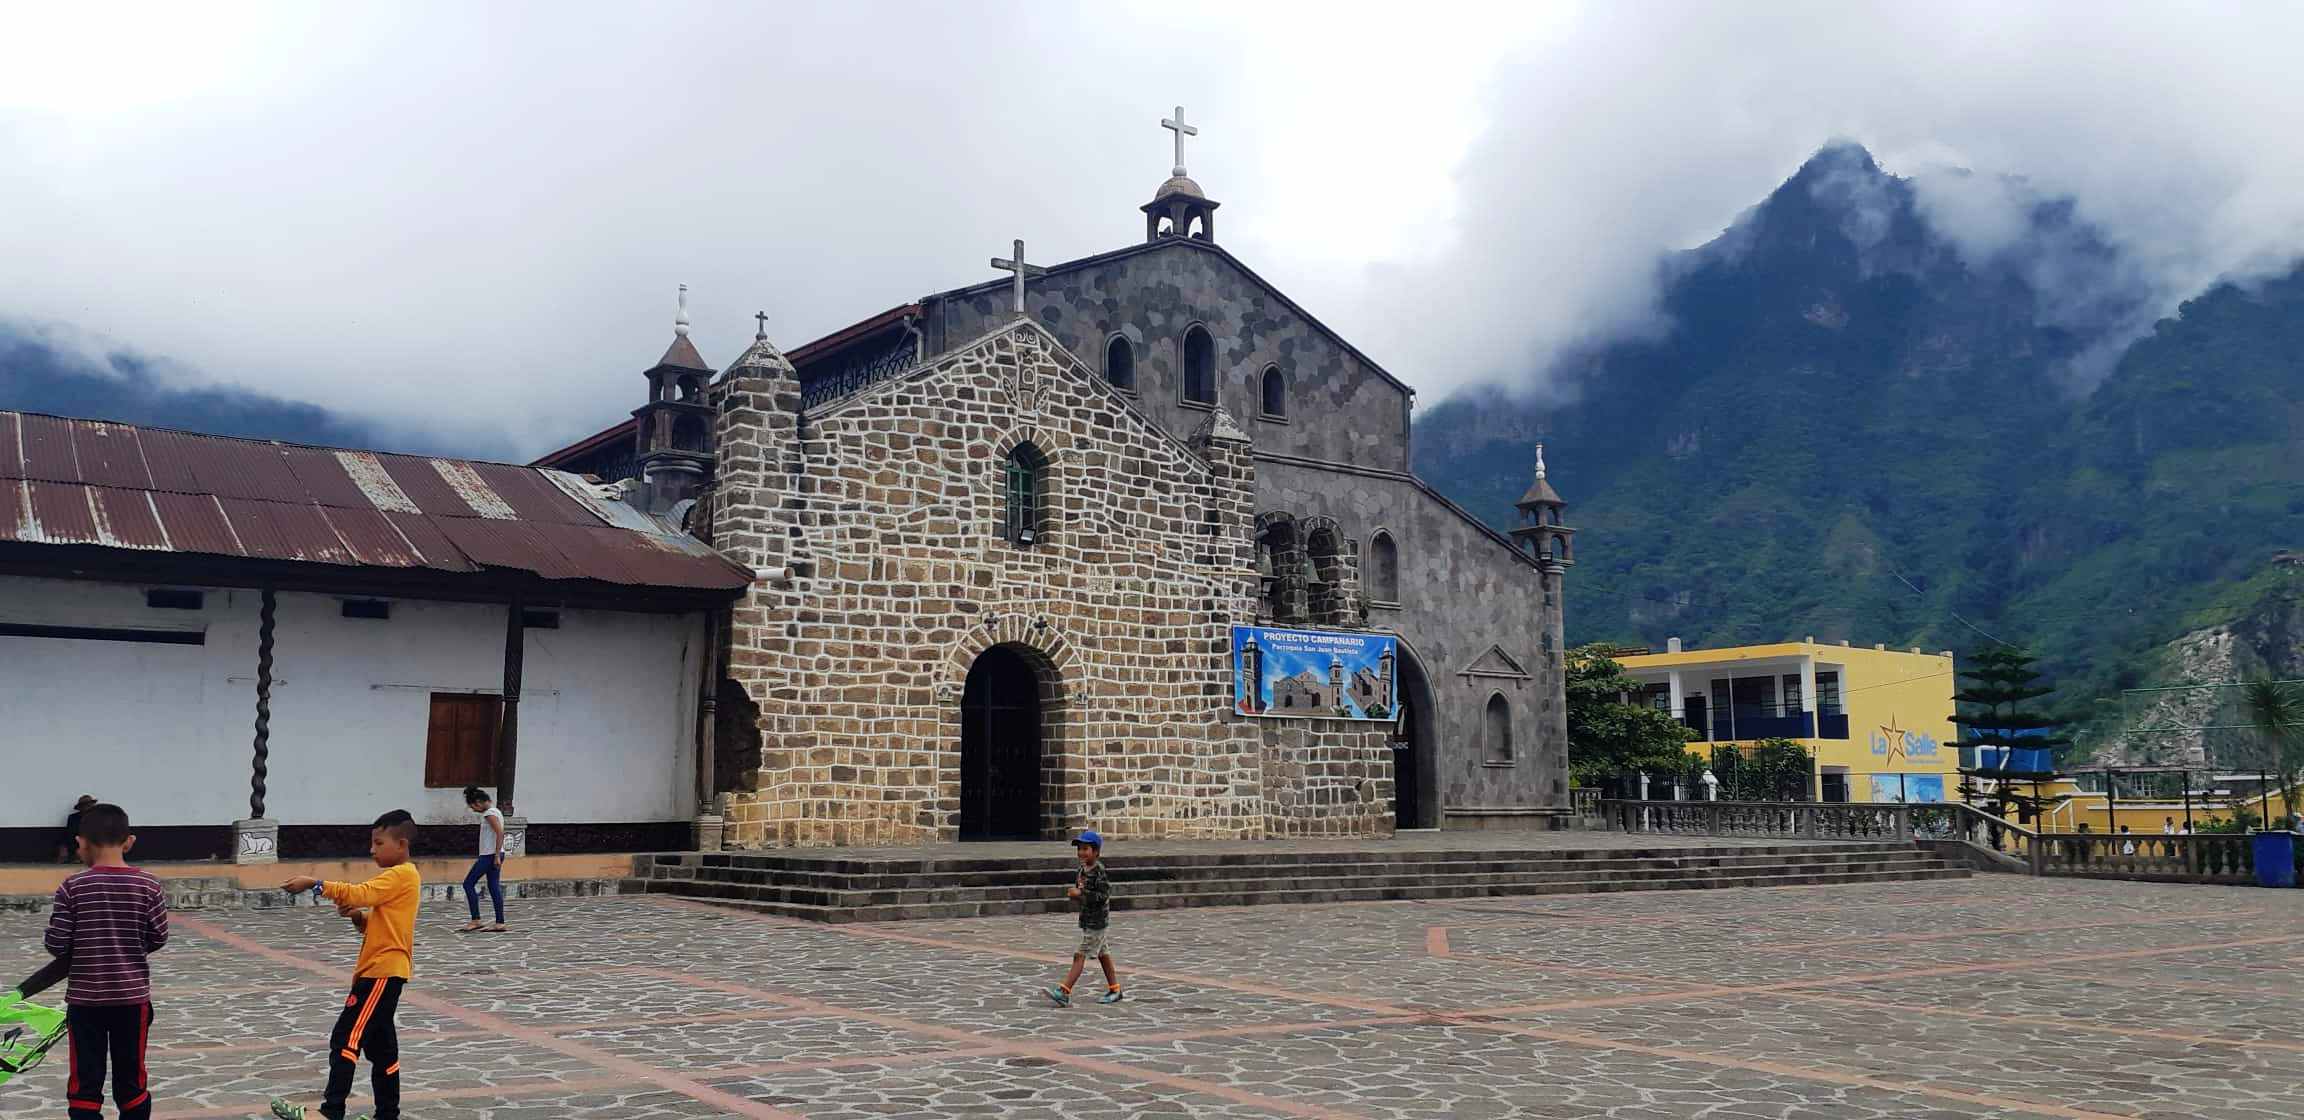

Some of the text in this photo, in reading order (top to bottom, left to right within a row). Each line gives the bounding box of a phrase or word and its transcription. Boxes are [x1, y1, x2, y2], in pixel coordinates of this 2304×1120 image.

[1263, 632, 1365, 647] PROYECTO CAMPANARIO
[1871, 731, 1937, 756] La Salle
